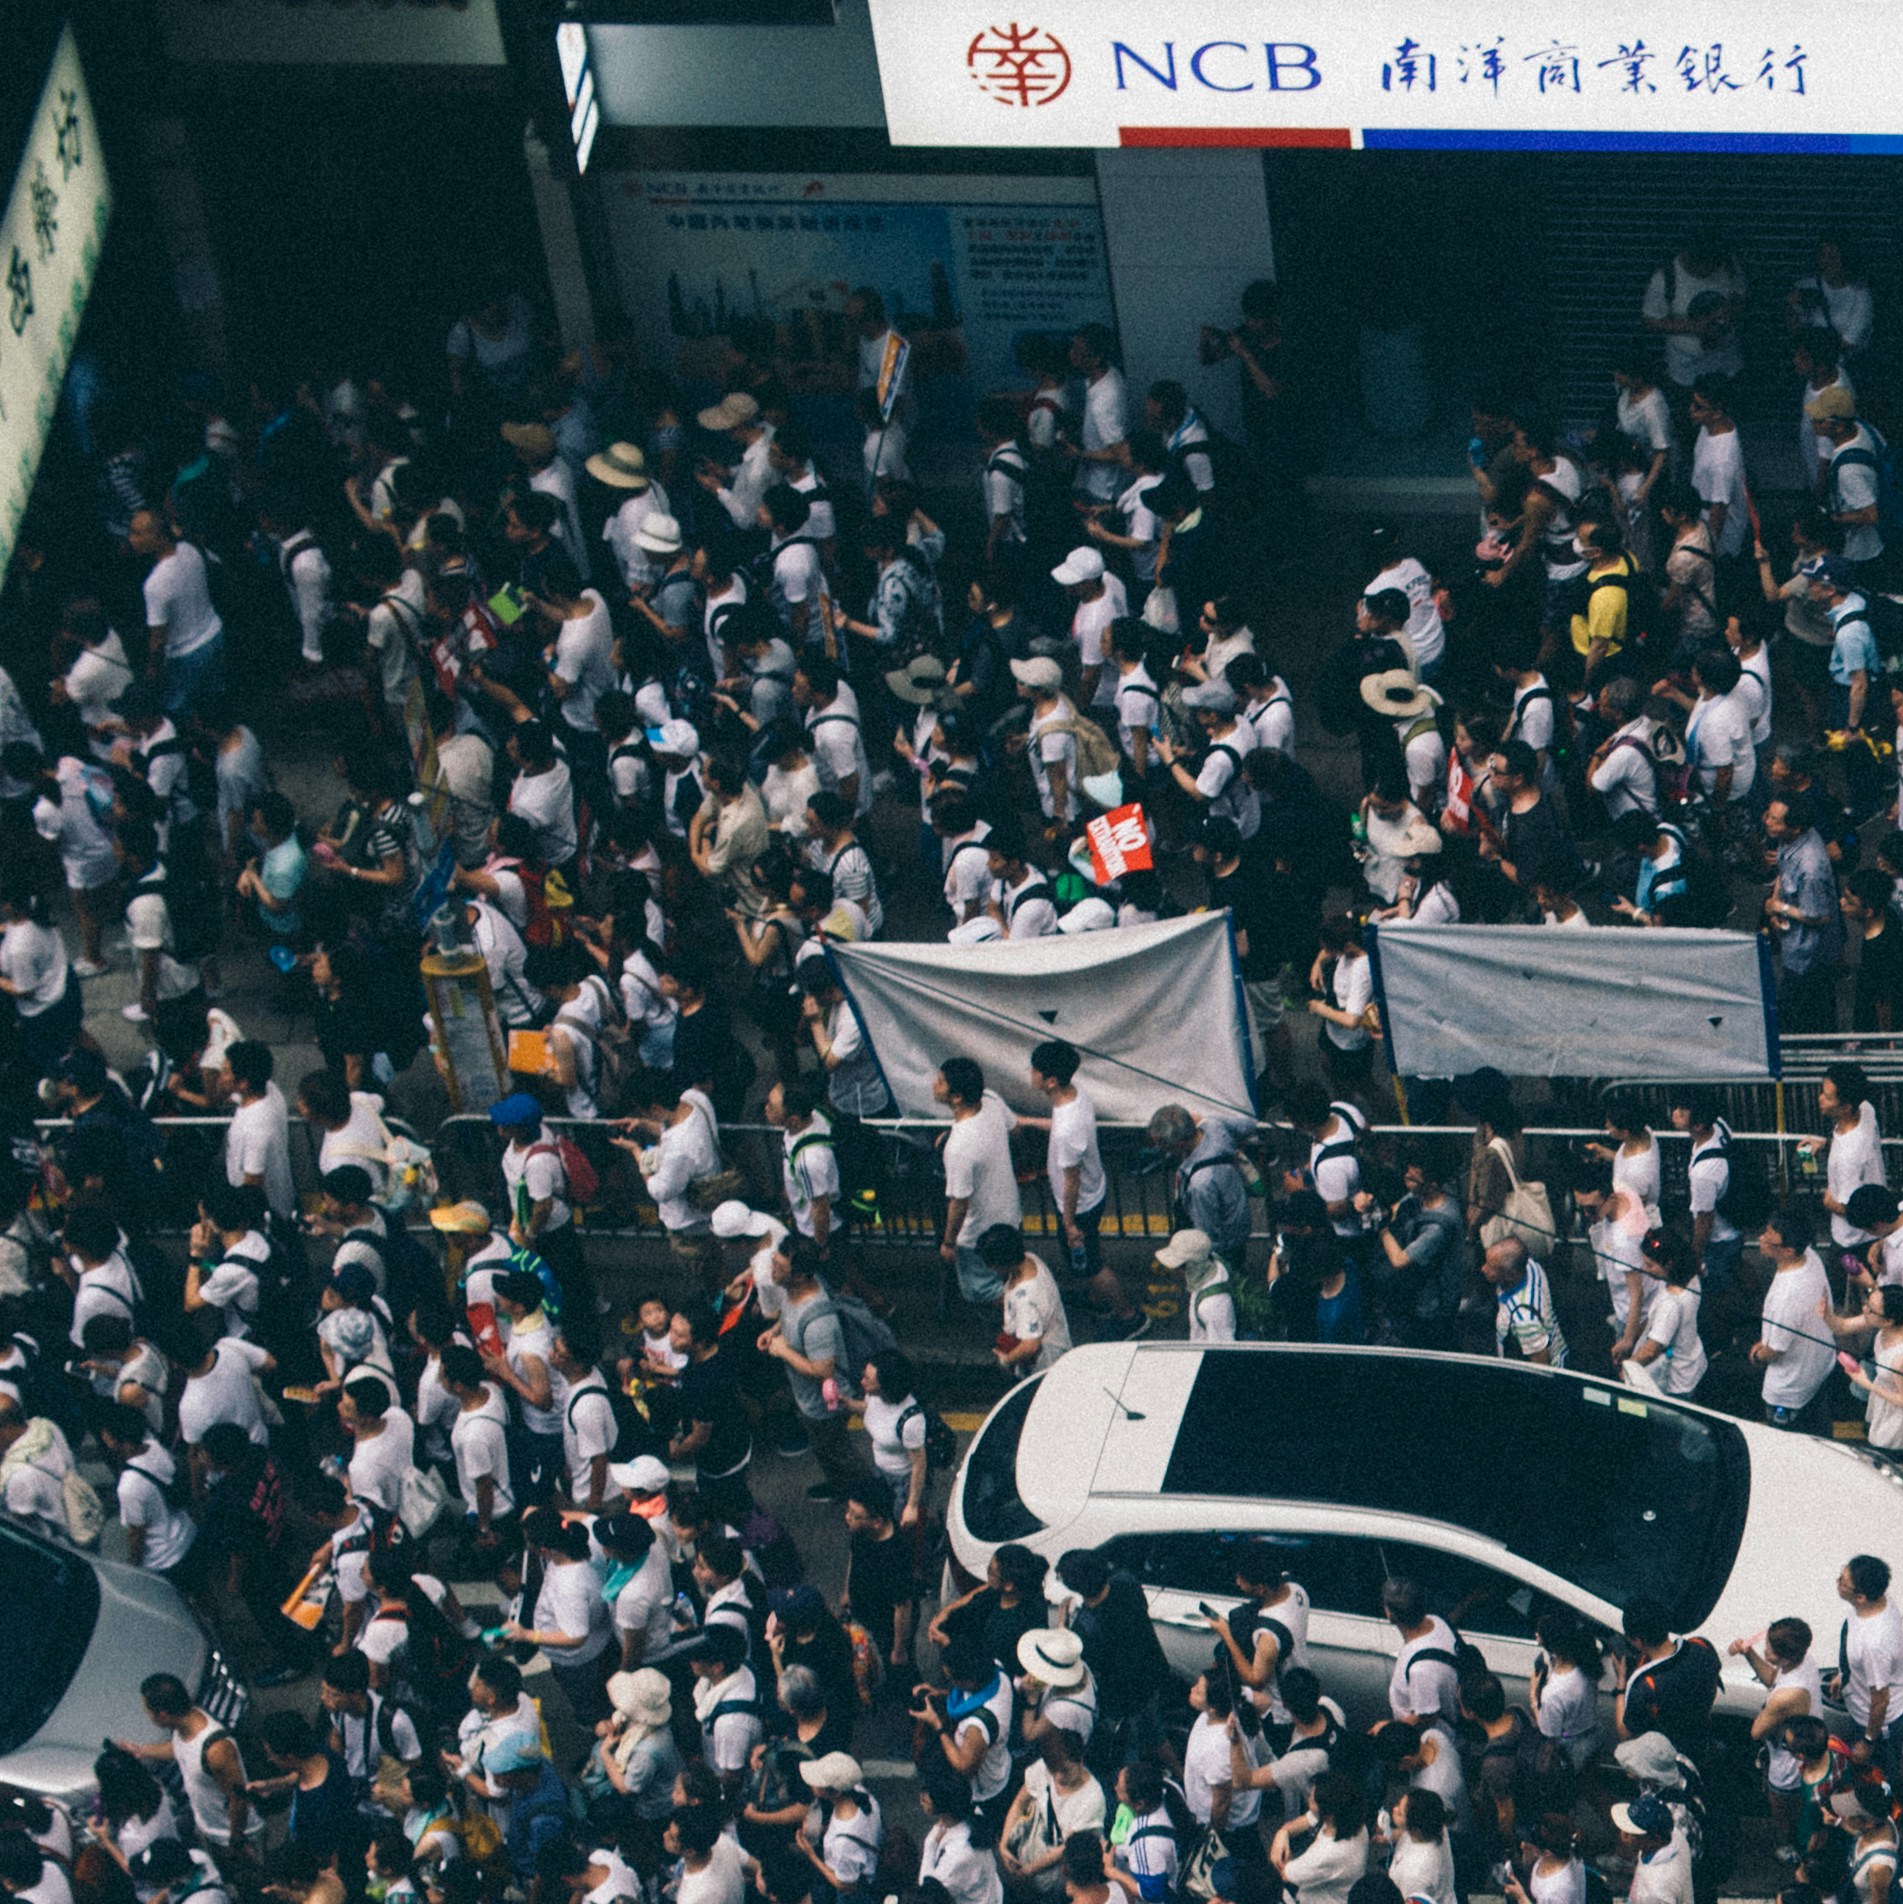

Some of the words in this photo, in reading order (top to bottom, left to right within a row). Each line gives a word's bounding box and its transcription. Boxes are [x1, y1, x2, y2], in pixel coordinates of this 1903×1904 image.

[1114, 41, 1323, 92] NCB
[1381, 35, 1810, 98] 南洋商業銀行
[1113, 814, 1150, 855] NO
